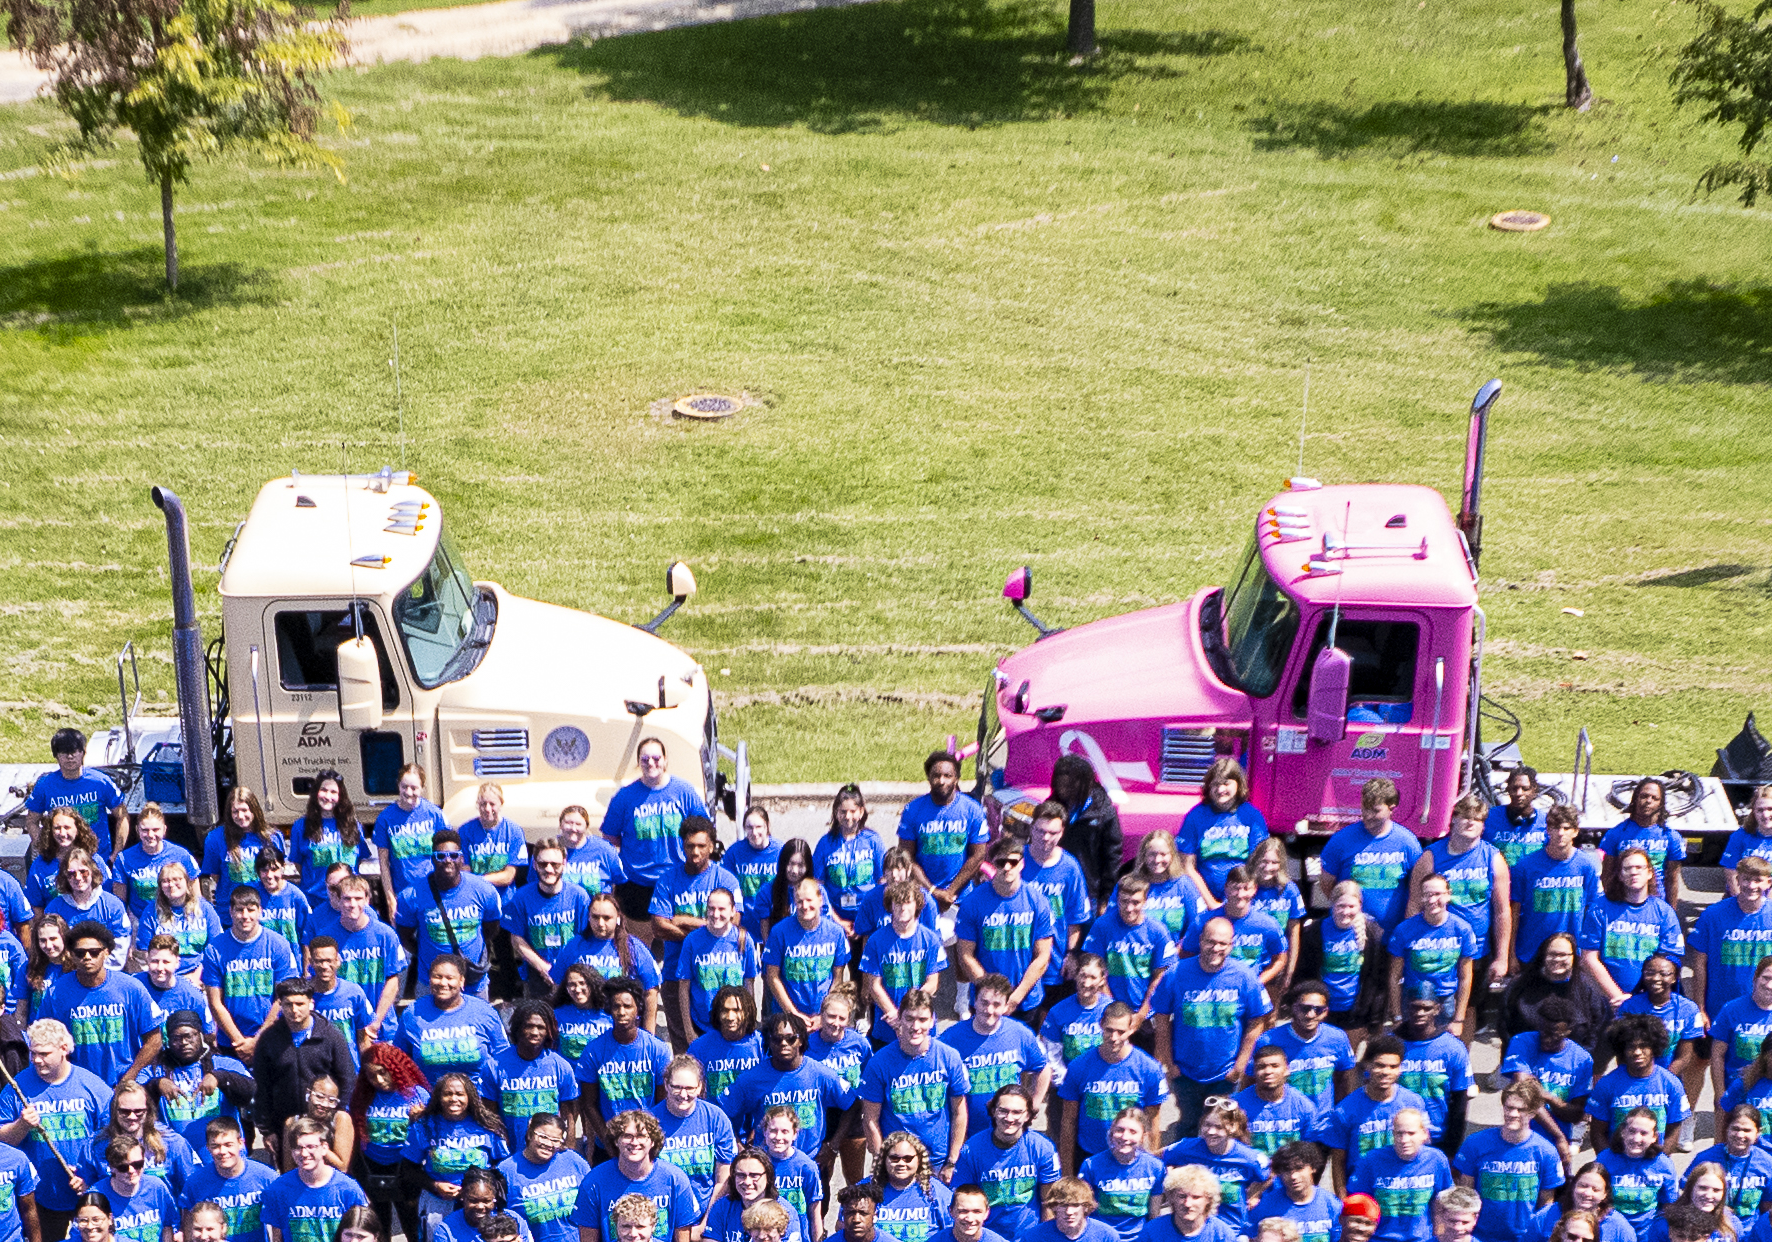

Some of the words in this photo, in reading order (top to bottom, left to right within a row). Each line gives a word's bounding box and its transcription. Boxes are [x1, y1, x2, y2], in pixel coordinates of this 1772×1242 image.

[291, 693, 313, 702] 23112
[297, 736, 331, 748] ADM
[1351, 748, 1389, 760] ADM
[281, 758, 302, 766] ADM
[304, 757, 336, 767] Trucking
[70, 1004, 125, 1019] ADM/MU
[501, 1075, 558, 1091] ADM/MU
[522, 1176, 578, 1197] ADM/MU
